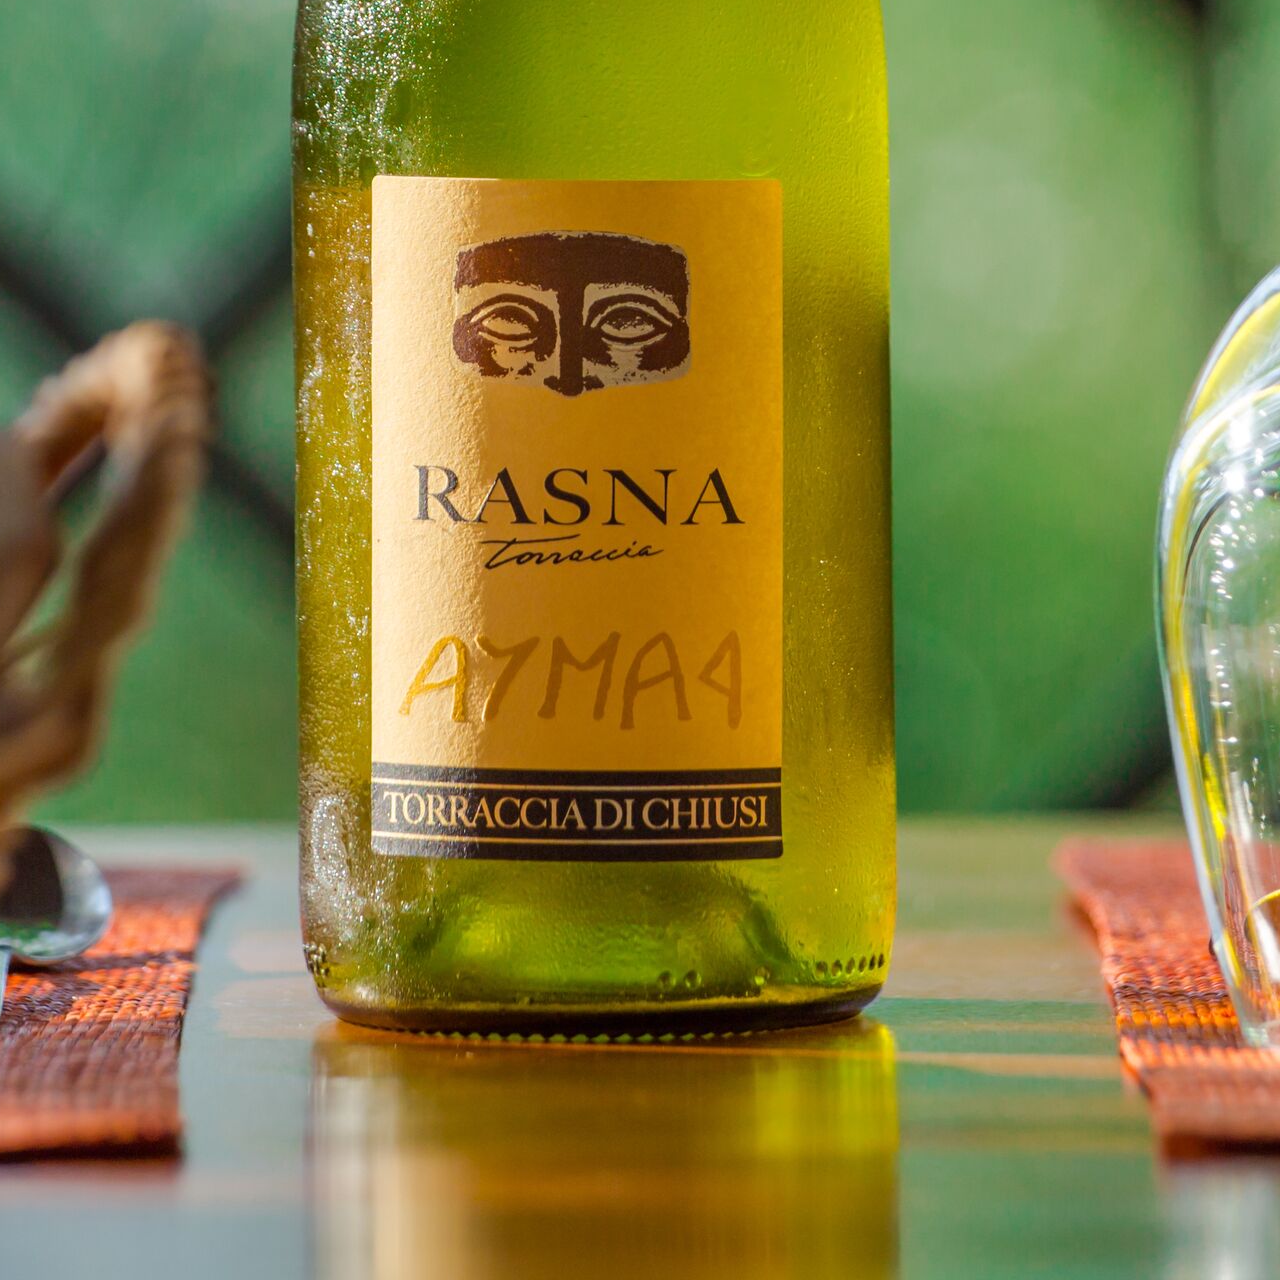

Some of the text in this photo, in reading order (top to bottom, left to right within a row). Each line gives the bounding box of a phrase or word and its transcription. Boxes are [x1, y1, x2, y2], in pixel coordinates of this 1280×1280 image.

[413, 464, 746, 526] RASNA
[383, 791, 768, 831] TORRACCIA DI CHIUSI
